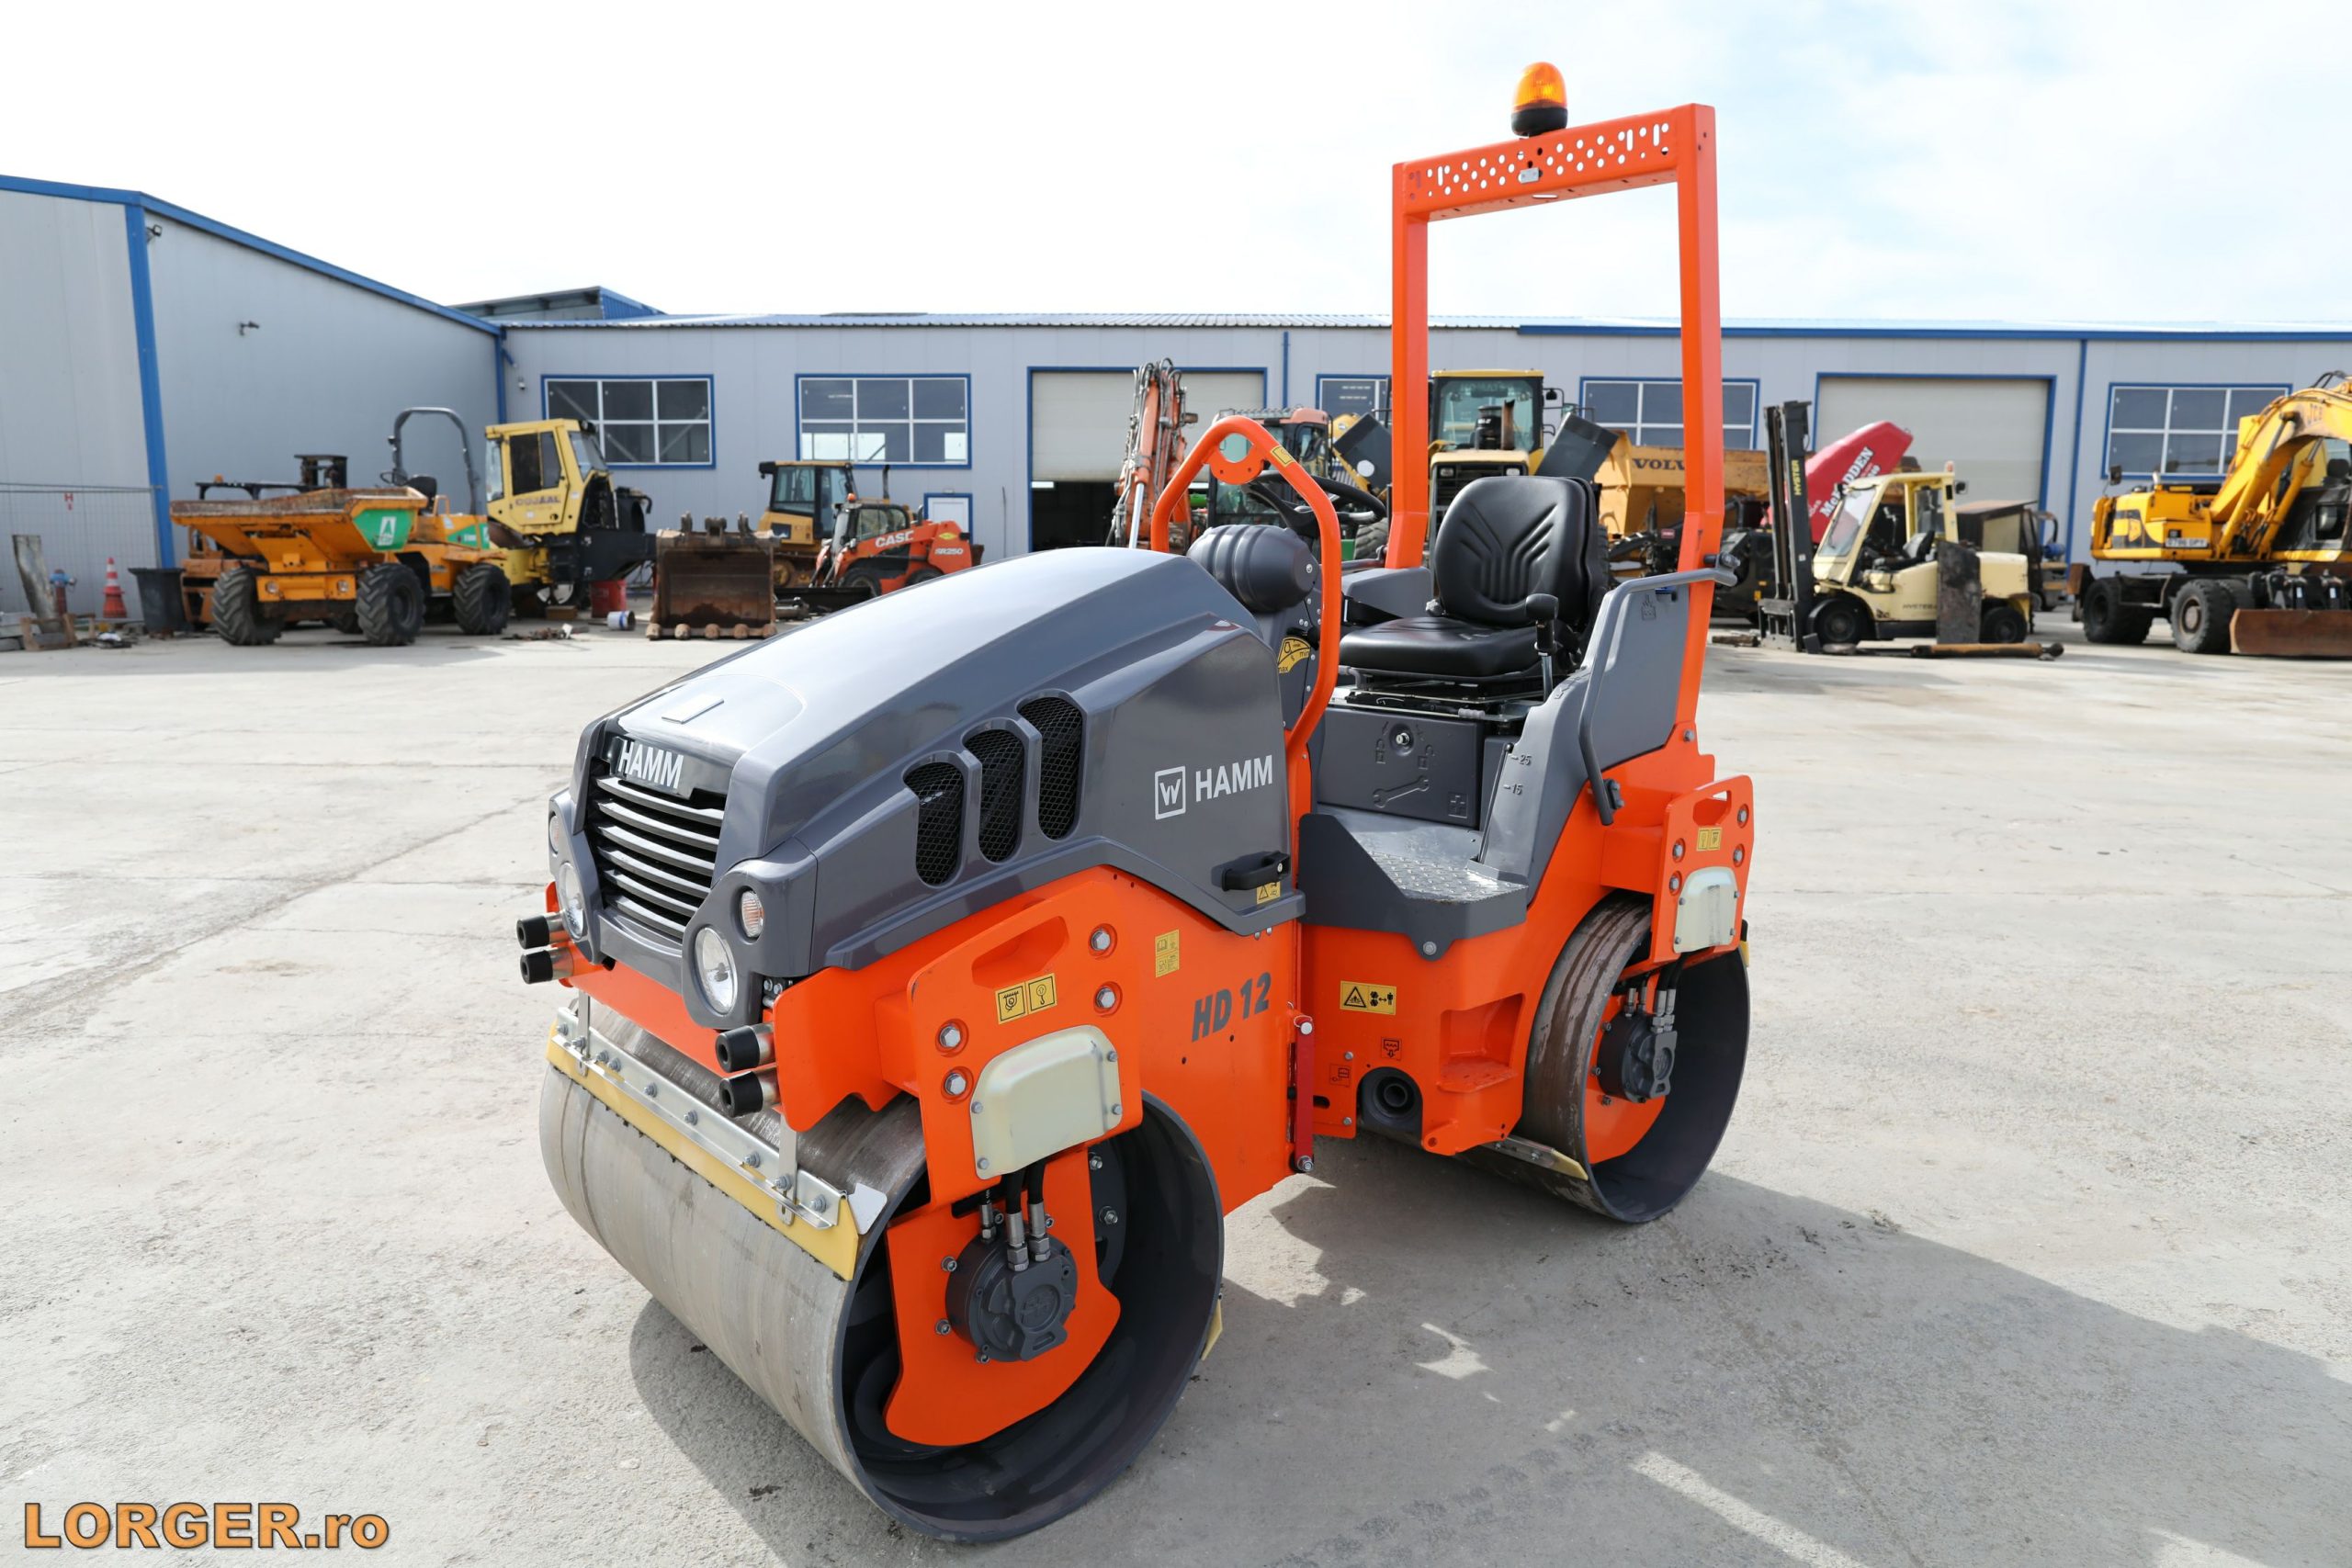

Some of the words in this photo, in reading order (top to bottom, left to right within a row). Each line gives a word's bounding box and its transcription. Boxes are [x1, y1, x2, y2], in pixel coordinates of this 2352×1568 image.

[1791, 459, 1803, 496] HYSTER
[875, 530, 915, 547] CASE
[934, 547, 964, 556] SR250
[617, 739, 684, 789] HAMM
[1519, 754, 1532, 766] 25
[1195, 754, 1272, 803] HAMM
[1512, 784, 1523, 795] 15
[1192, 988, 1232, 1043] HD
[1240, 971, 1272, 1020] 12
